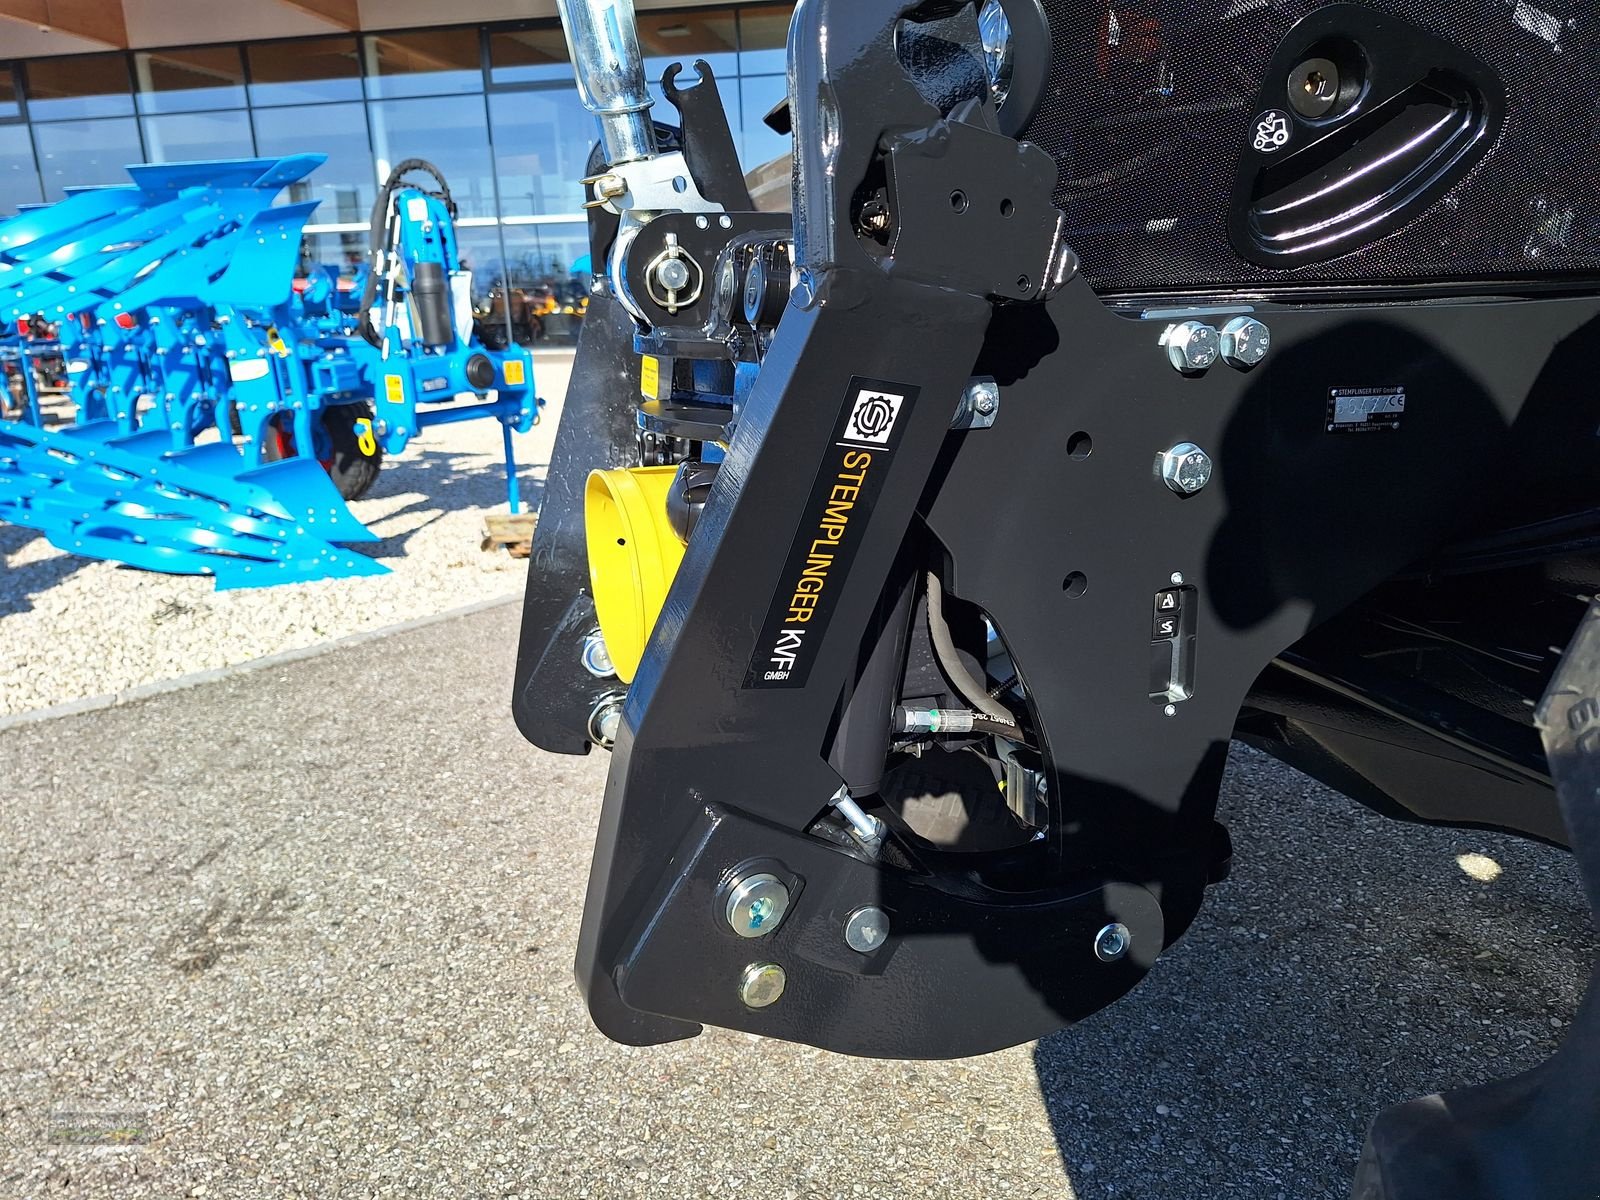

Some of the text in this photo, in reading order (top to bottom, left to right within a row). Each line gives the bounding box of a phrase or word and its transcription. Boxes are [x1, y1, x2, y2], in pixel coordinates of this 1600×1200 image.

[1338, 388, 1372, 396] STEMPLINGER
[770, 450, 872, 671] STEMPLINGER KVF
[763, 670, 791, 680] GMBH
